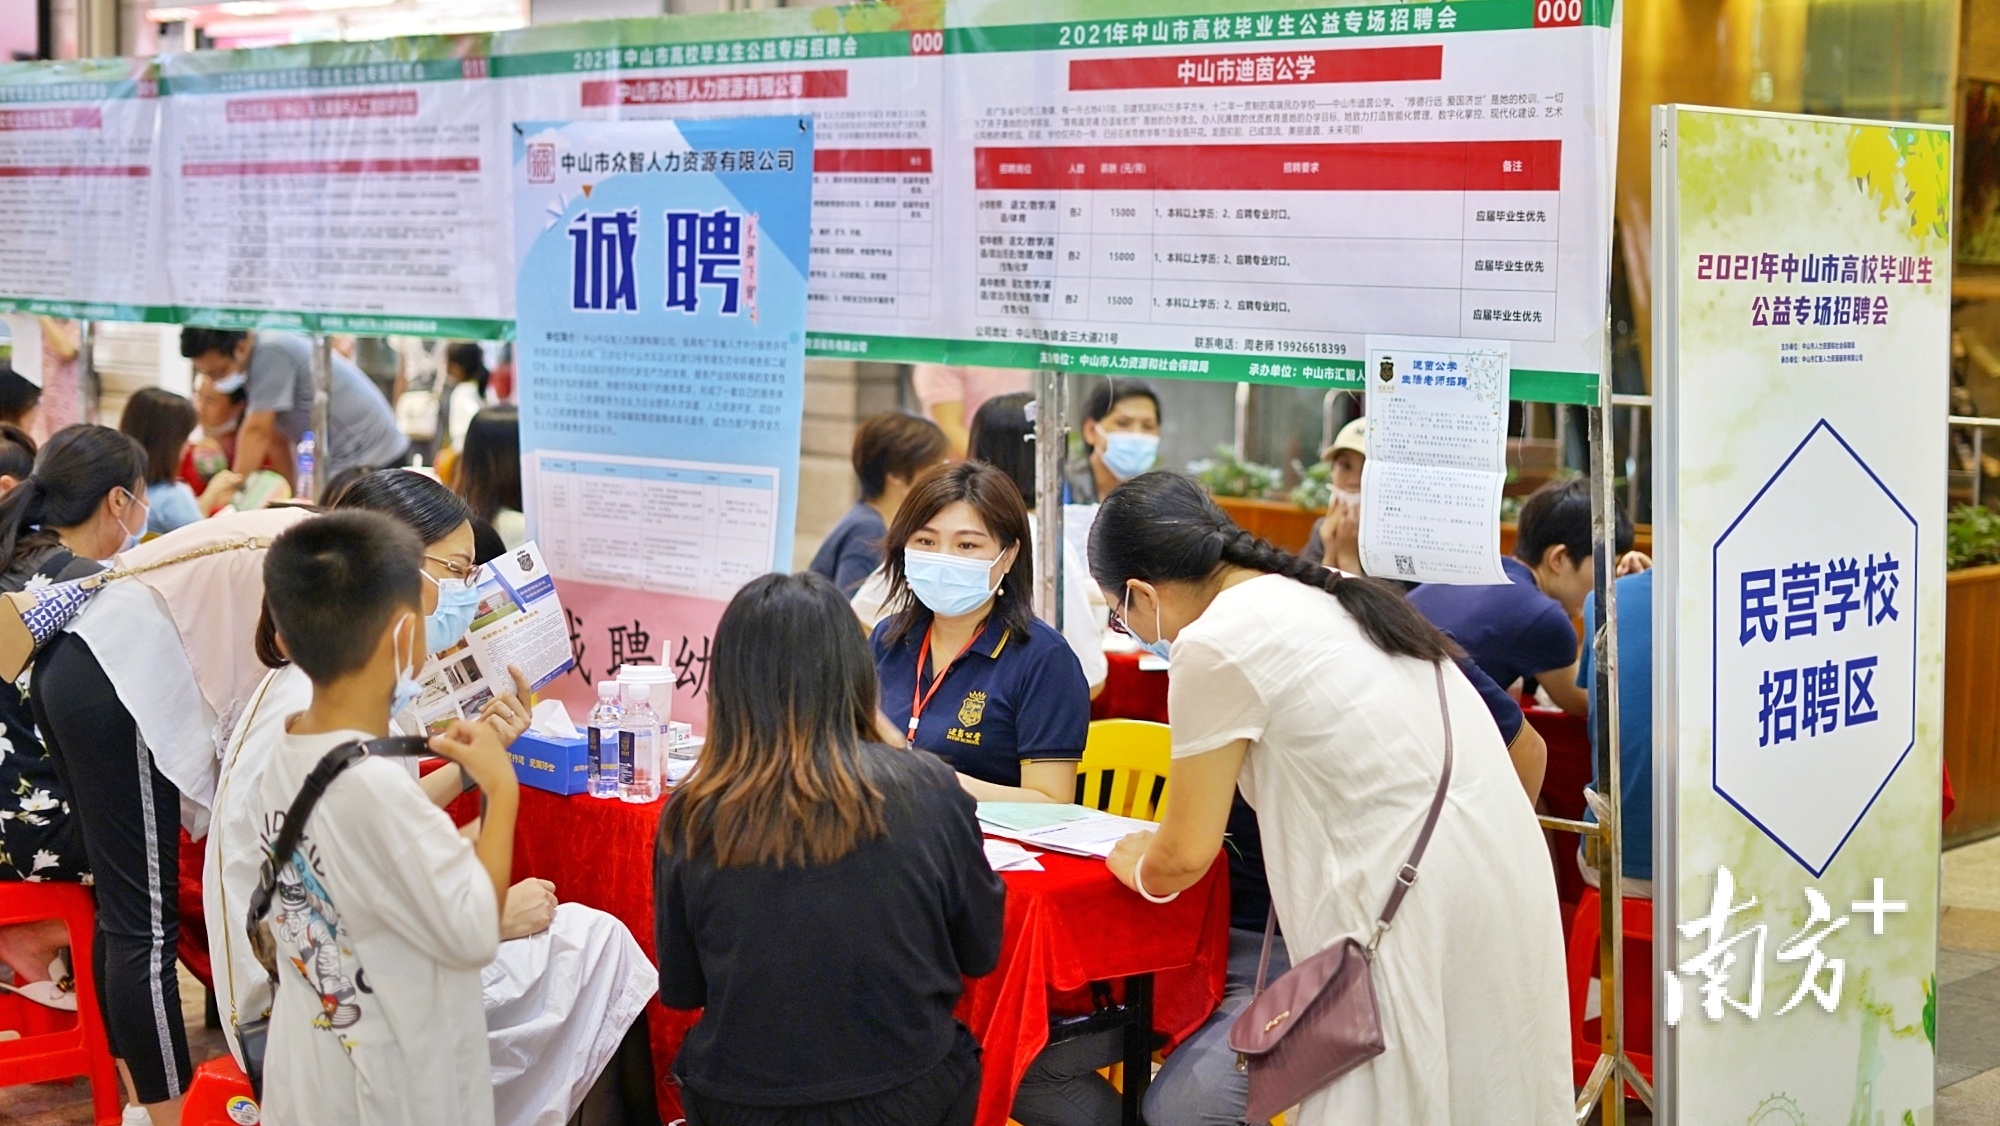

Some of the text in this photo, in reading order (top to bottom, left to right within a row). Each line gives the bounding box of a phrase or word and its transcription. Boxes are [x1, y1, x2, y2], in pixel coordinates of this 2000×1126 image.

[1537, 0, 1582, 24] 000
[1059, 6, 1458, 46] 2021年中山市高校毕业生公益专场招聘会
[912, 32, 943, 53] 000
[1177, 55, 1316, 85] 中山市迪茵公学
[561, 150, 794, 174] 中山市众智人力资源有限公司
[1283, 162, 1320, 174] 招聘要求
[1502, 160, 1523, 173] 备注
[1110, 207, 1136, 218] 15000
[1475, 210, 1547, 223] 应届毕业生优先
[1109, 251, 1135, 262] 15000
[1474, 260, 1545, 273] 应届毕业生优先
[1697, 252, 1933, 284] 2021年中山市高校毕业生
[1107, 295, 1133, 306] 15000
[1472, 309, 1542, 323] 应届毕业生优先
[1752, 295, 1889, 326] 公益专场招聘会
[1277, 340, 1347, 355] 19926618399
[1401, 374, 1468, 388] 生活老师招聘
[1739, 552, 1900, 648] 民营学校
[1758, 655, 1879, 748] 招聘区
